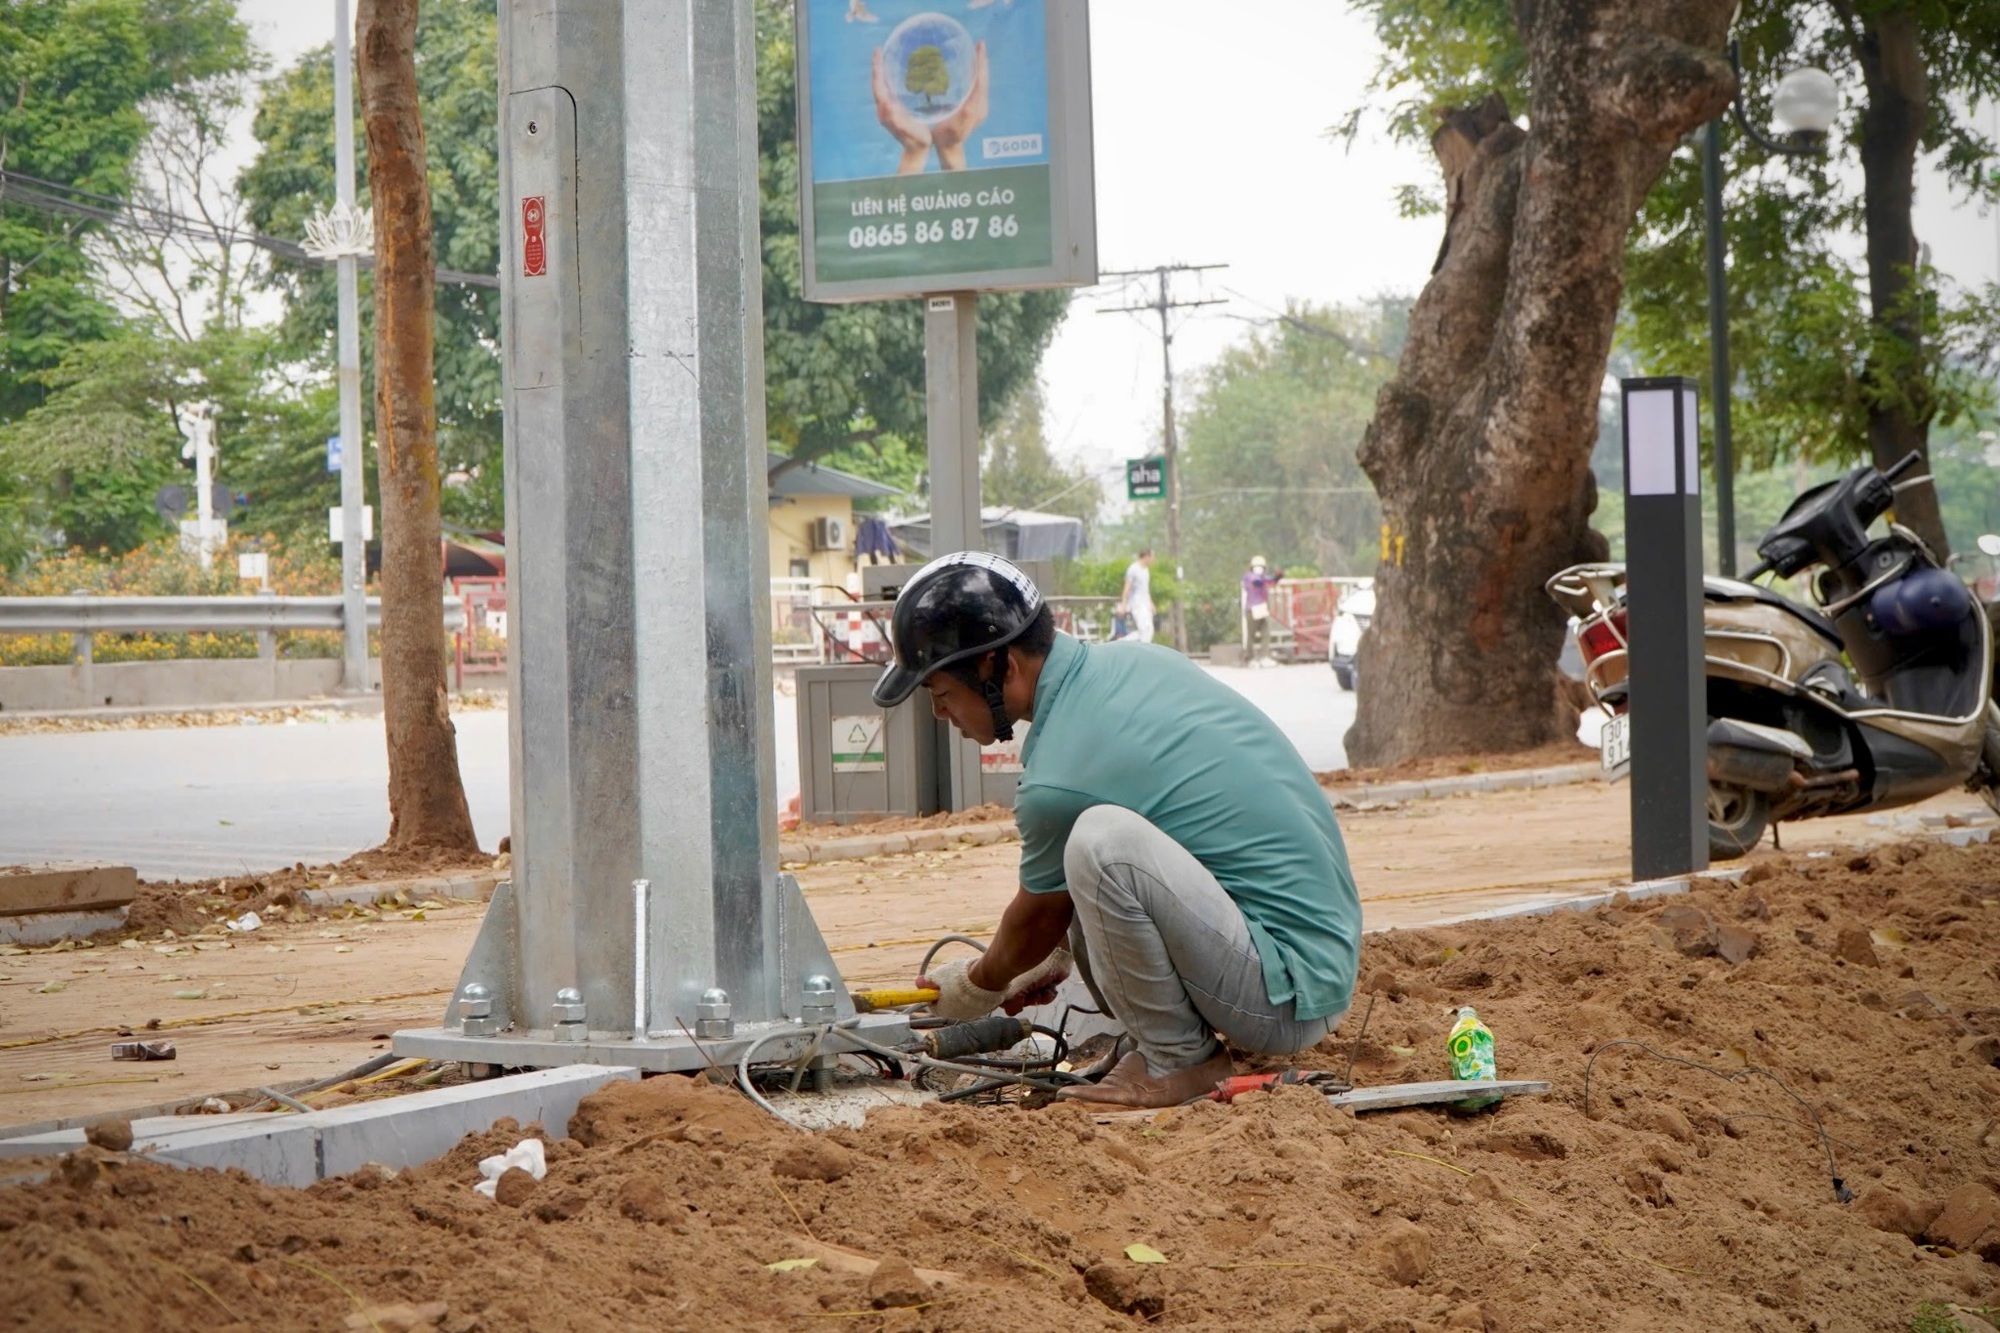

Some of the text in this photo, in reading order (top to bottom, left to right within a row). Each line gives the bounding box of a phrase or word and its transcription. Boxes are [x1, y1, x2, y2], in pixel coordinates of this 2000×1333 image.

[851, 186, 1015, 217] LIÊN HỆ QUẢNG CÁO
[848, 214, 1019, 249] 0865 86 87 86
[1608, 720, 1630, 743] 30-
